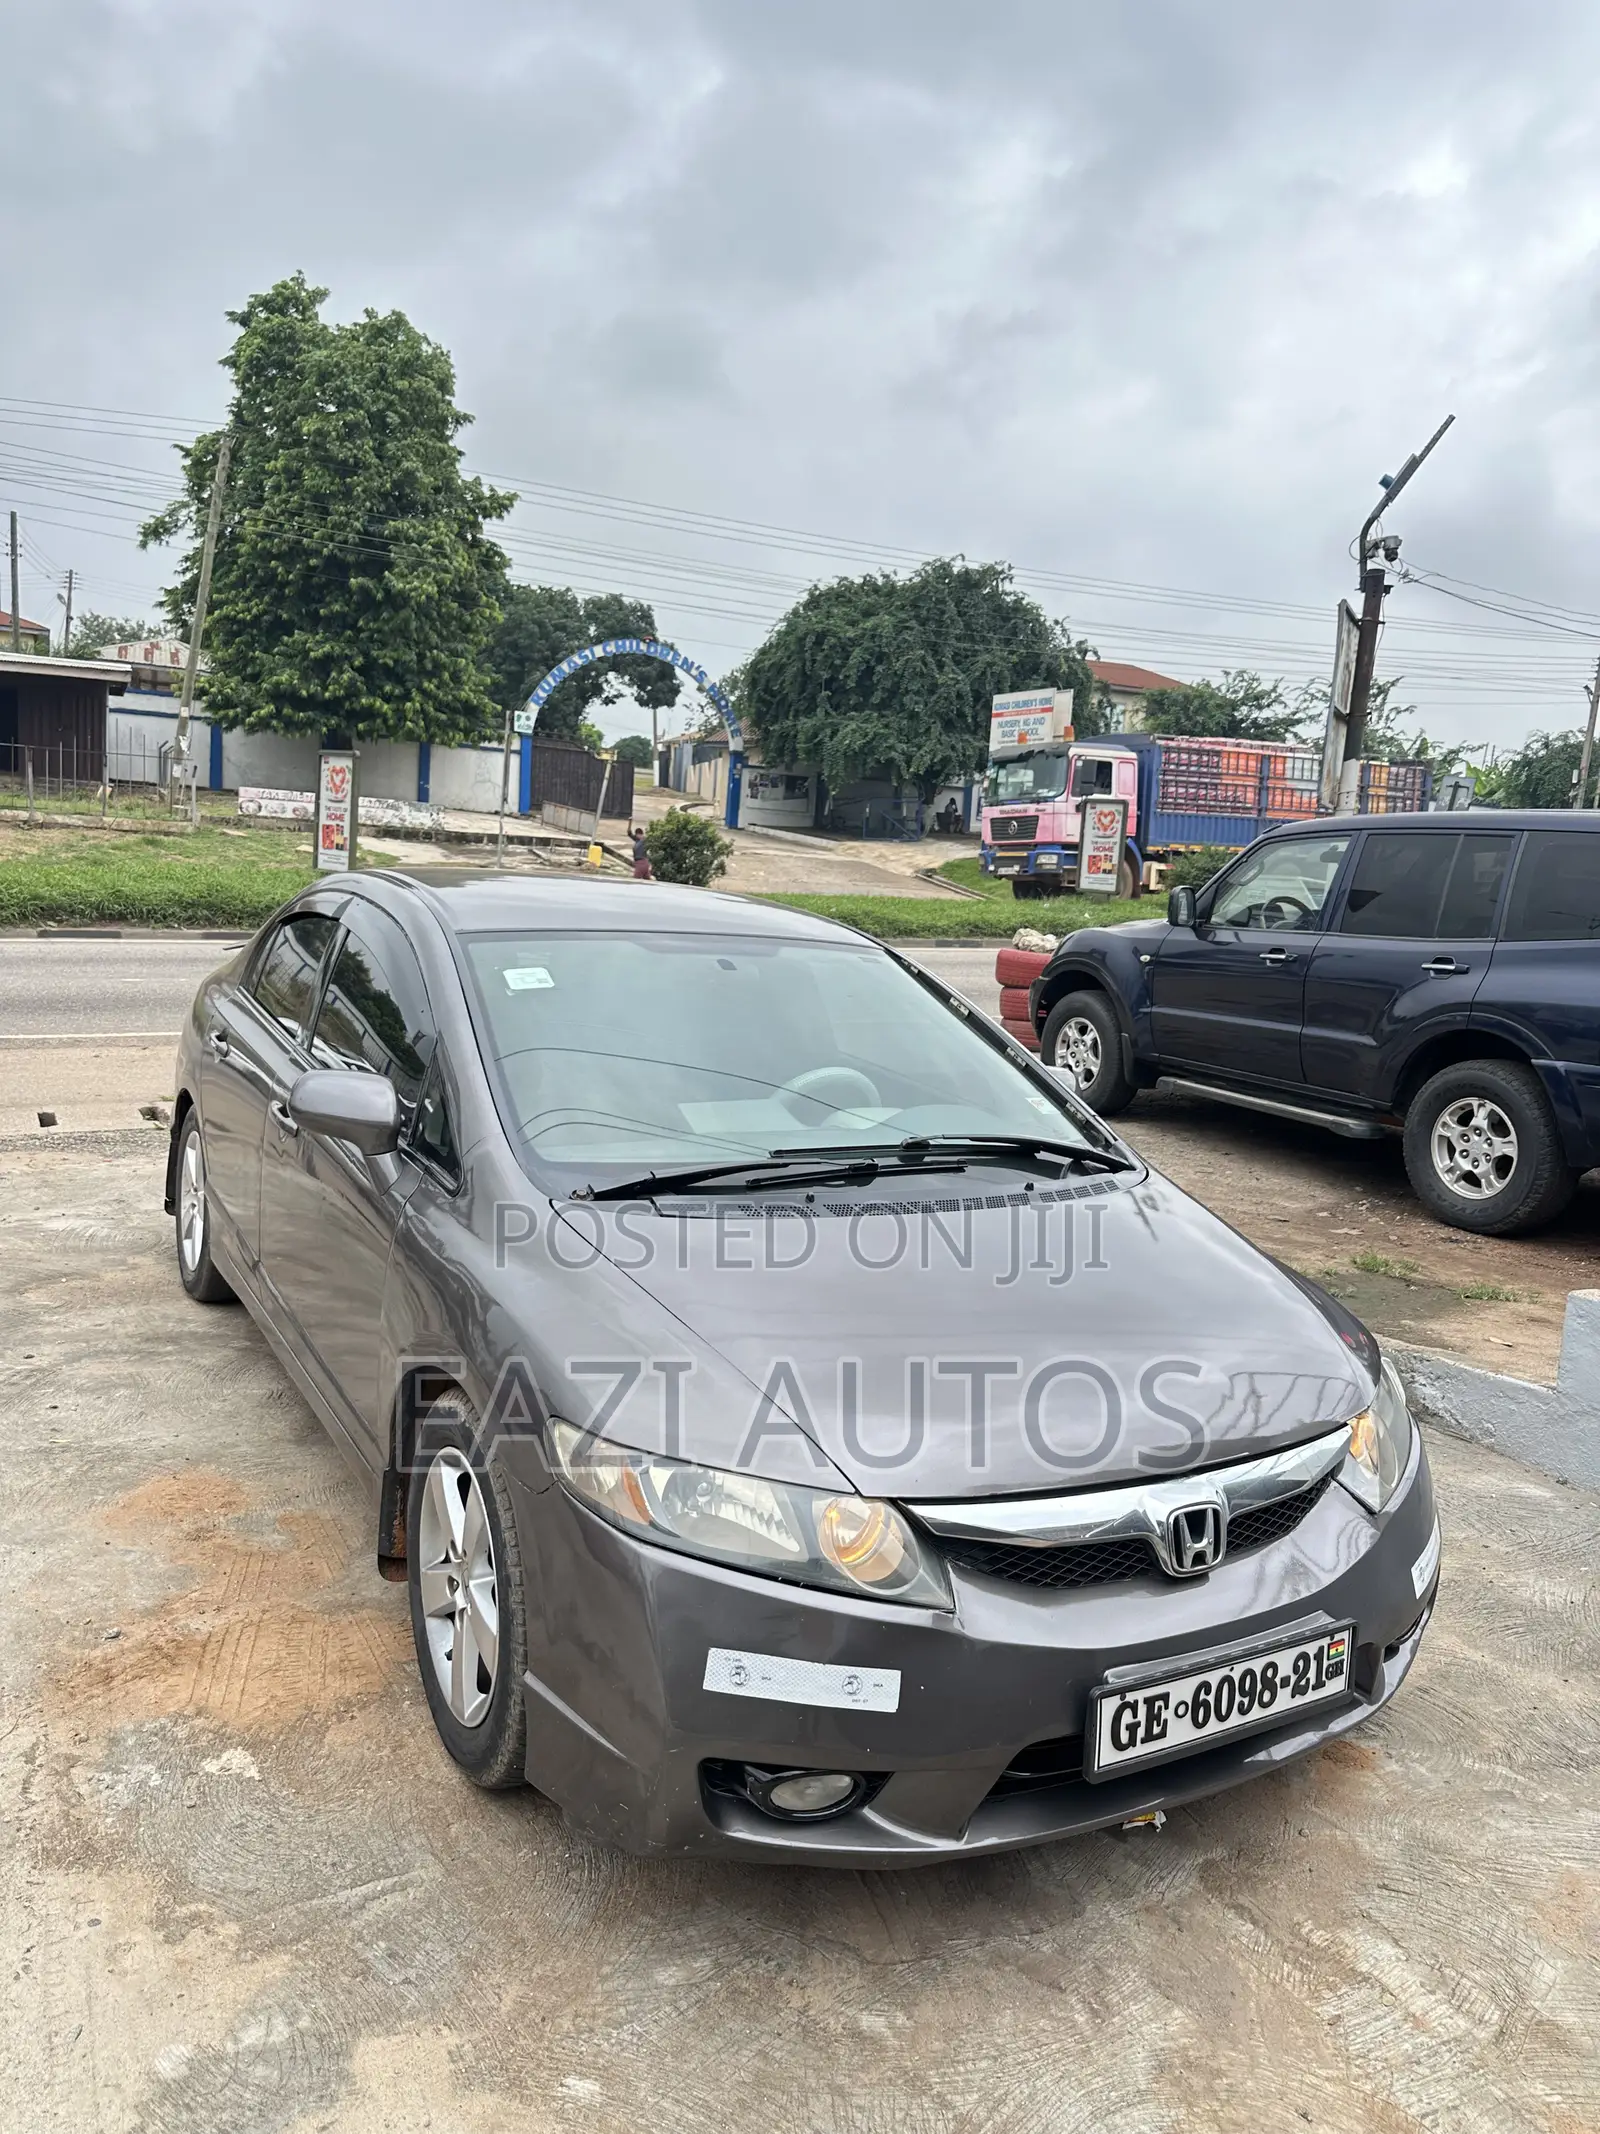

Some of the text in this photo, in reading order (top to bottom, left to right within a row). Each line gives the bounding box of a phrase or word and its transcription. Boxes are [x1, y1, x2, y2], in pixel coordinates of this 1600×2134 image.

[530, 646, 596, 707] KUMASI
[601, 639, 708, 684] CHILDREN'S
[326, 813, 345, 822] HOME
[1092, 845, 1115, 853] HOME
